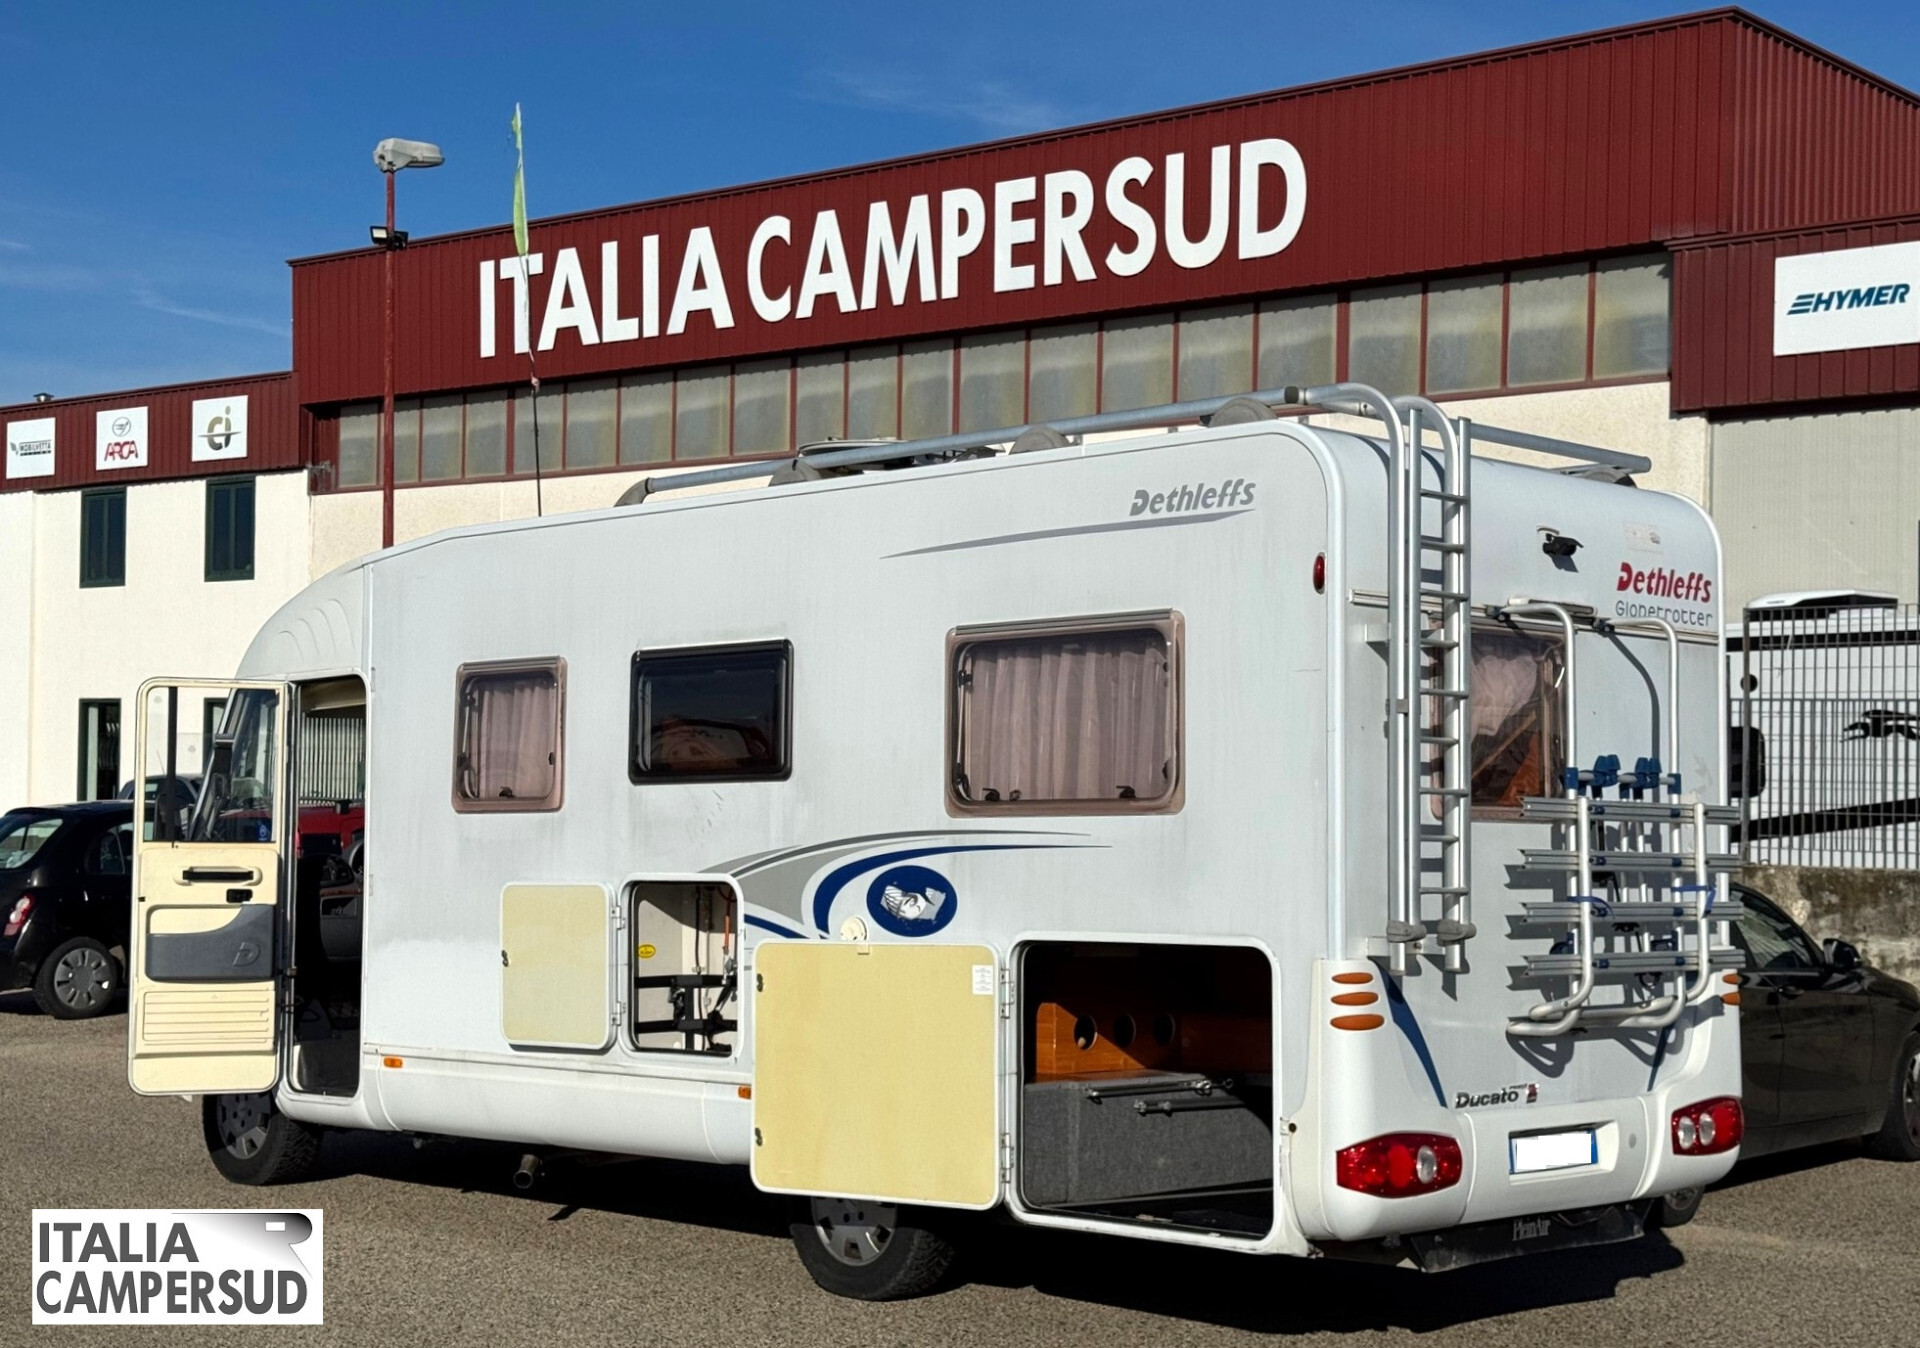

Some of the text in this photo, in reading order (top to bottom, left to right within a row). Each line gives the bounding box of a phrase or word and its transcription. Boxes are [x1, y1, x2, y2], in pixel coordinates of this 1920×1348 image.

[480, 138, 1307, 359] ITALIA CAMPERSUD
[104, 440, 139, 461] ARCA
[1129, 478, 1257, 517] Dethleffs
[1616, 561, 1713, 604] Dethleffs
[1455, 1087, 1520, 1109] Ducato
